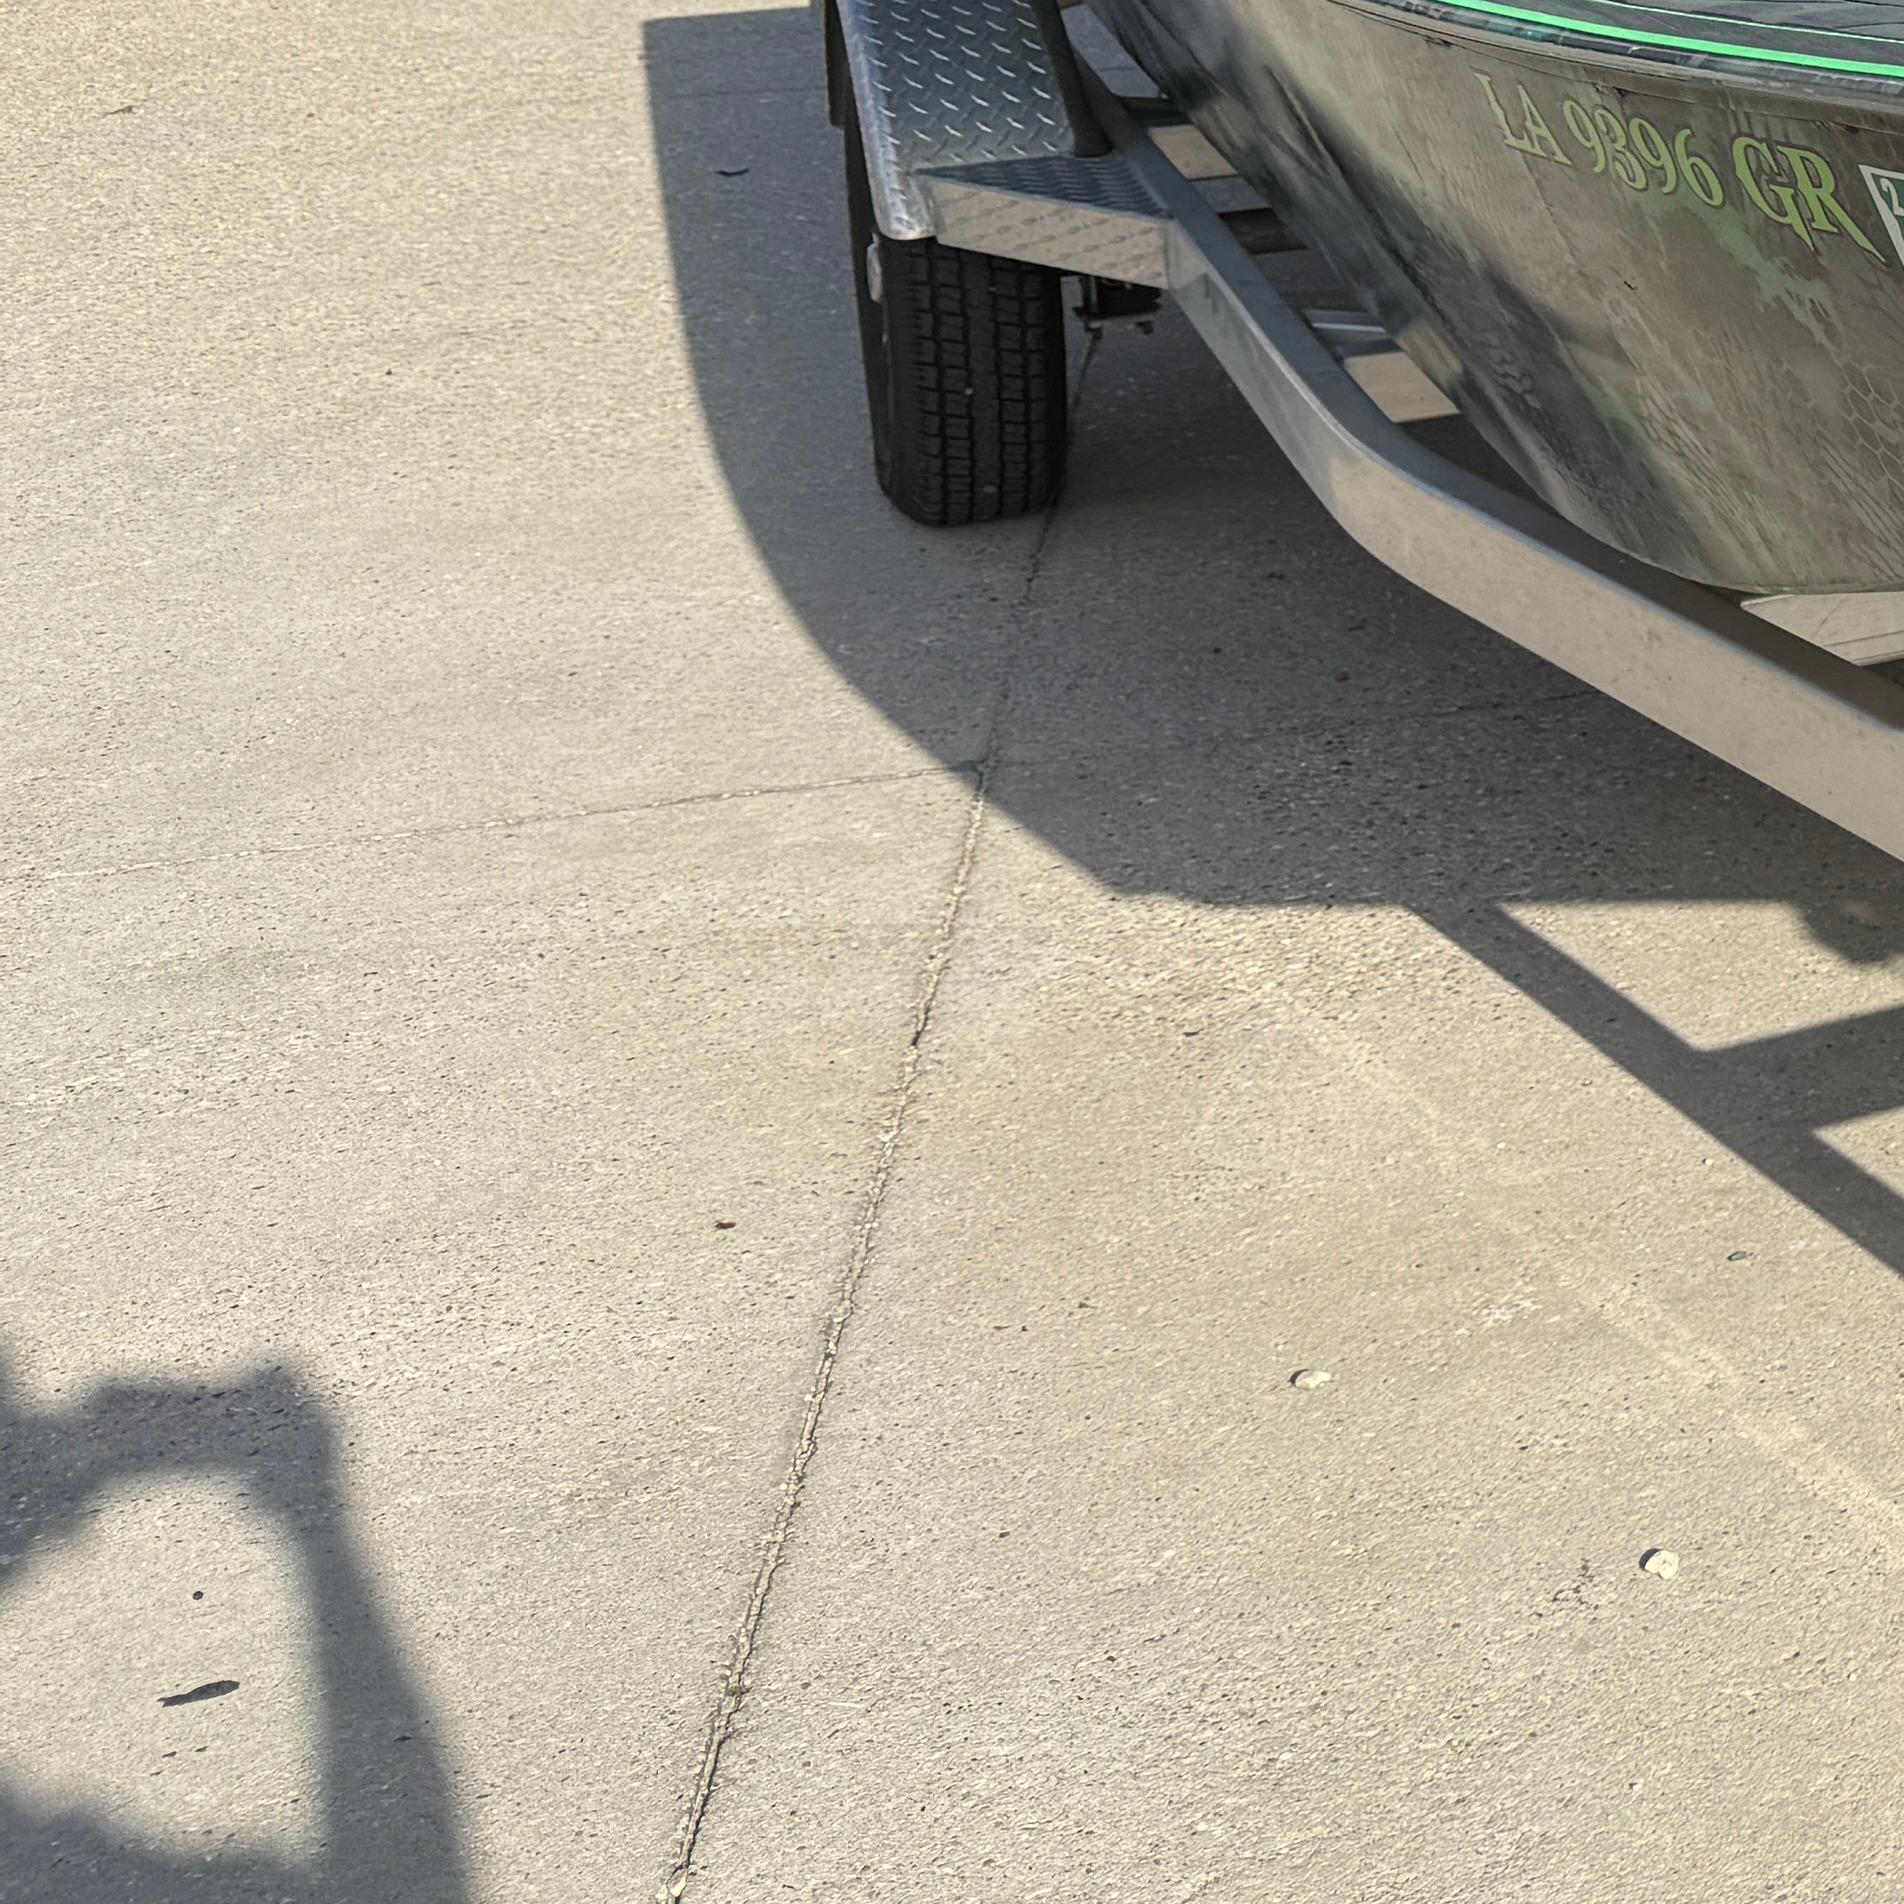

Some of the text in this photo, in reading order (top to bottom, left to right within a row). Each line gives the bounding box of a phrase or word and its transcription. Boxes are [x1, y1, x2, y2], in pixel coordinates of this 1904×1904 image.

[1472, 71, 1888, 265] LA 9396 GR
